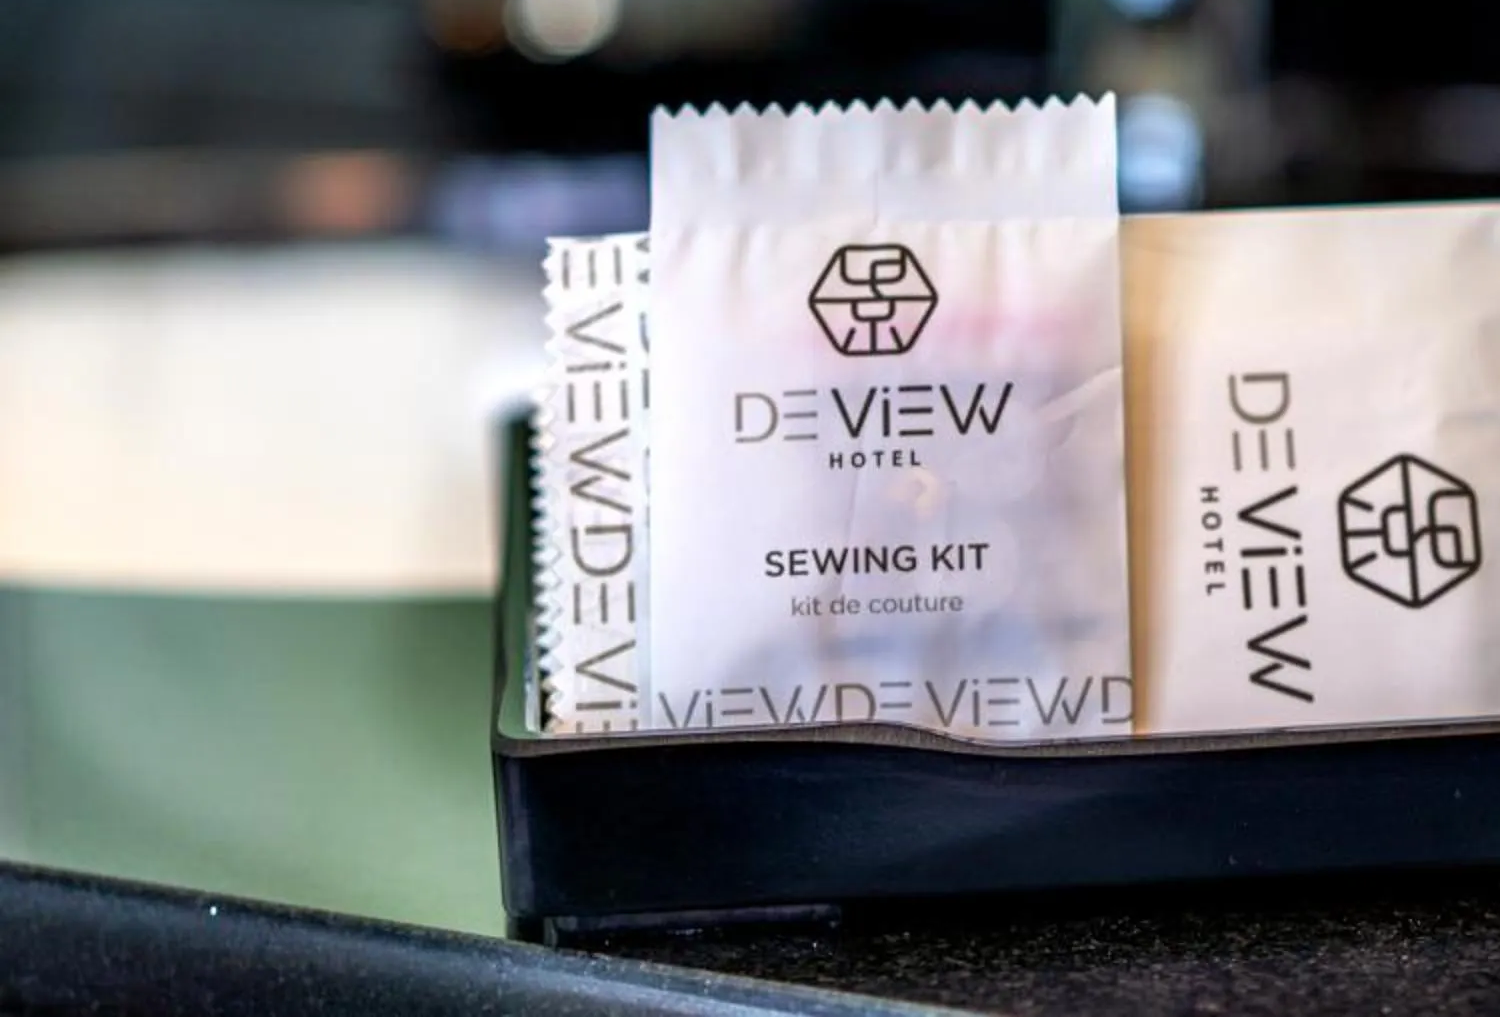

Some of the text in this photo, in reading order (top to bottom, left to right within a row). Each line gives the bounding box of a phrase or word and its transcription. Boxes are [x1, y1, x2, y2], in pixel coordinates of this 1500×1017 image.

[829, 449, 922, 470] HOTEL
[1200, 486, 1226, 596] HOTEL
[764, 543, 990, 578] SEWING KIT
[790, 595, 965, 617] kit de couture
